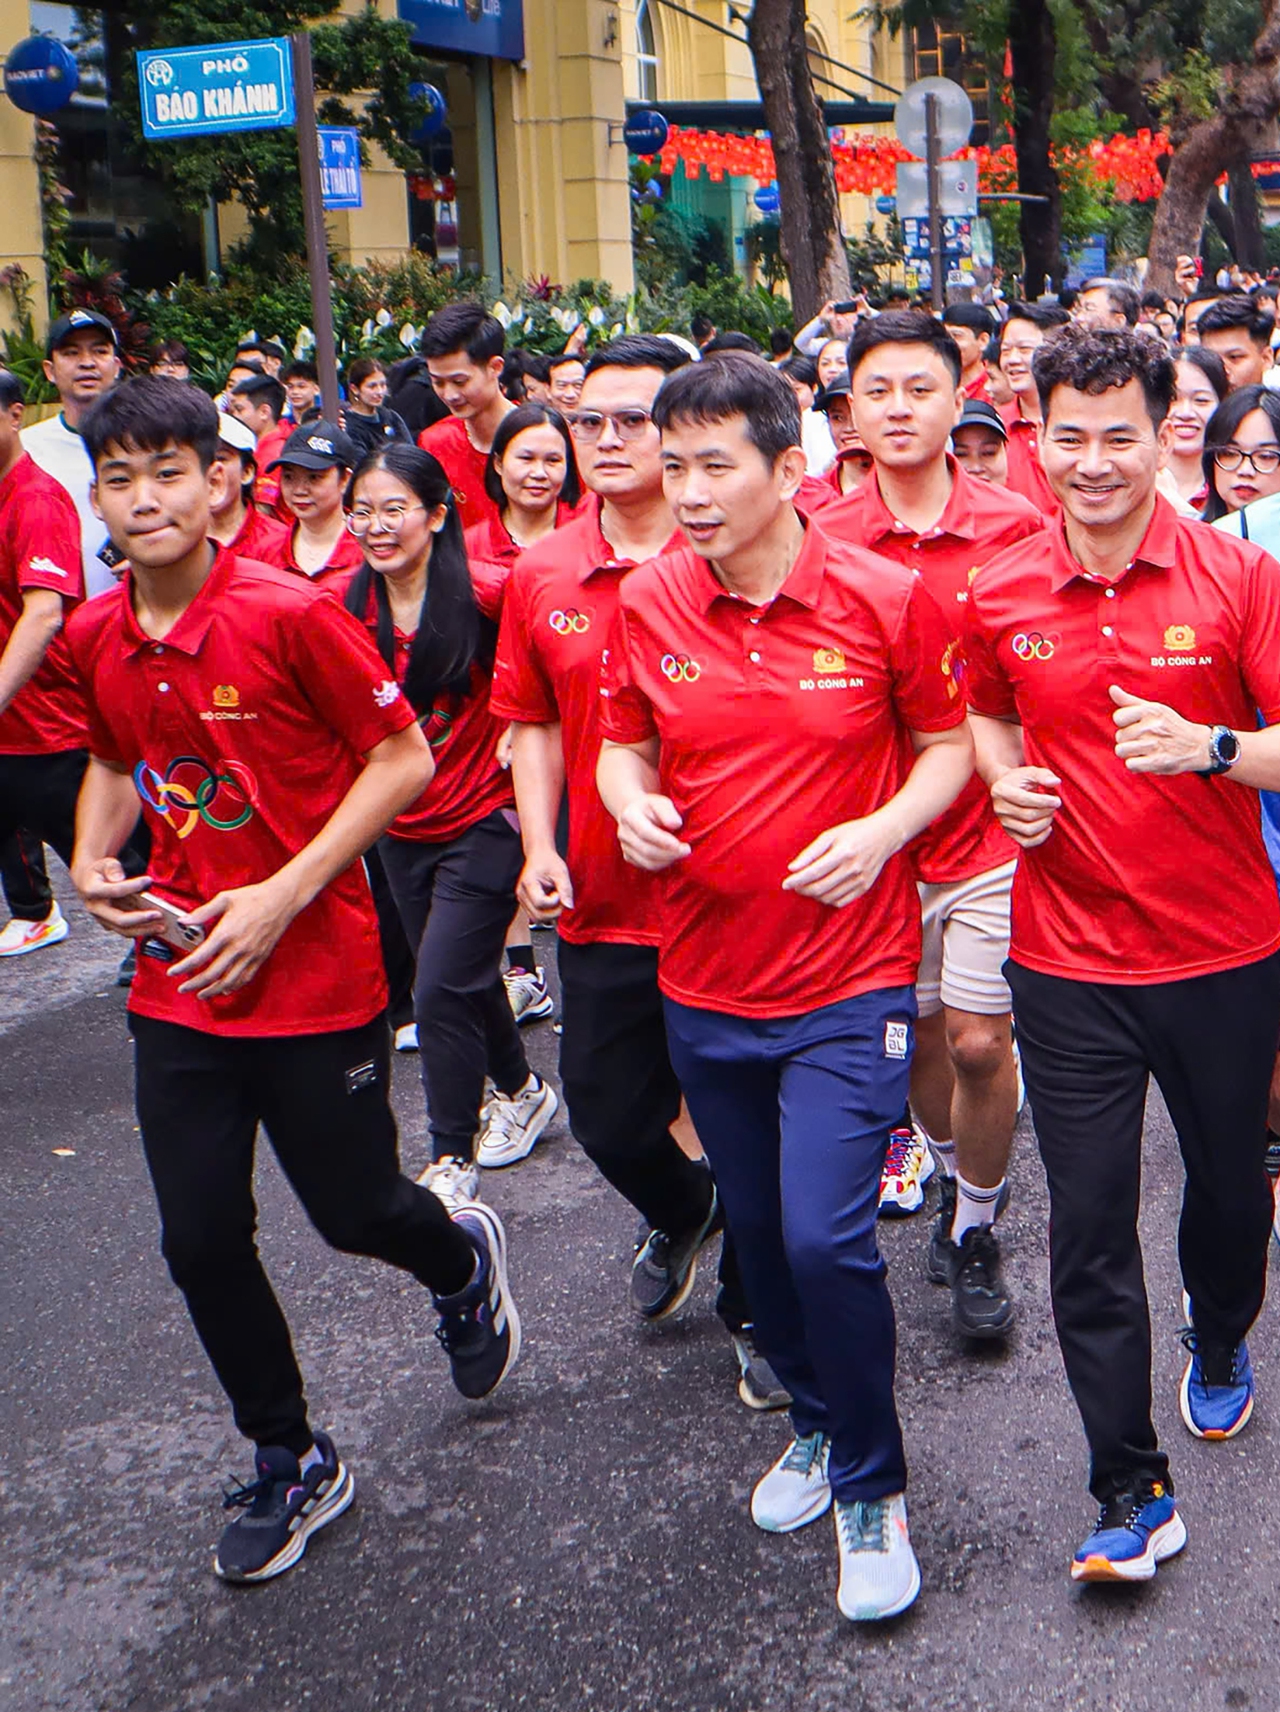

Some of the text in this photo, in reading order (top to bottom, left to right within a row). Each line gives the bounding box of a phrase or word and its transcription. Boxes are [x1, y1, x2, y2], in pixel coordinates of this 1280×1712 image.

[202, 51, 248, 76] PHỐ
[203, 79, 278, 117] KHÁNH
[1167, 656, 1197, 667] CÔNG
[1198, 656, 1213, 666] AN
[849, 677, 864, 688] AN
